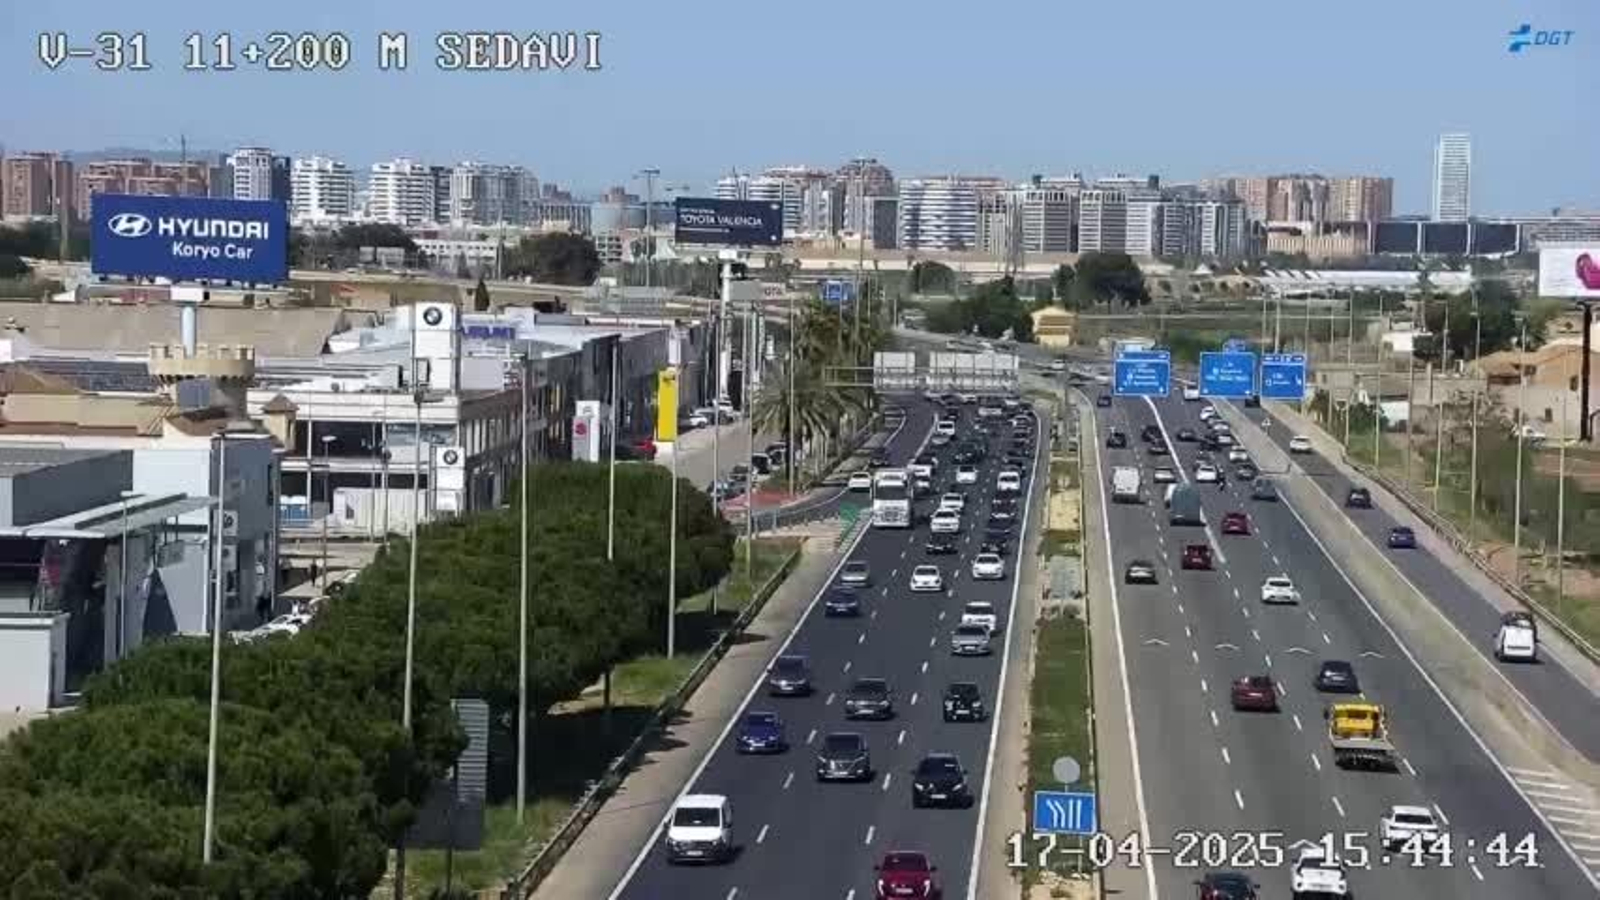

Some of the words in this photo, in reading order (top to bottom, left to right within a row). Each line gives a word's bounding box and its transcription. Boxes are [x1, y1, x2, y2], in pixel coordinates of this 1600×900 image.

[158, 217, 269, 239] HYUNDAI
[680, 214, 715, 225] TOYOTA
[717, 216, 763, 226] VALENCIA
[172, 241, 220, 260] Koryo
[224, 243, 253, 259] Car
